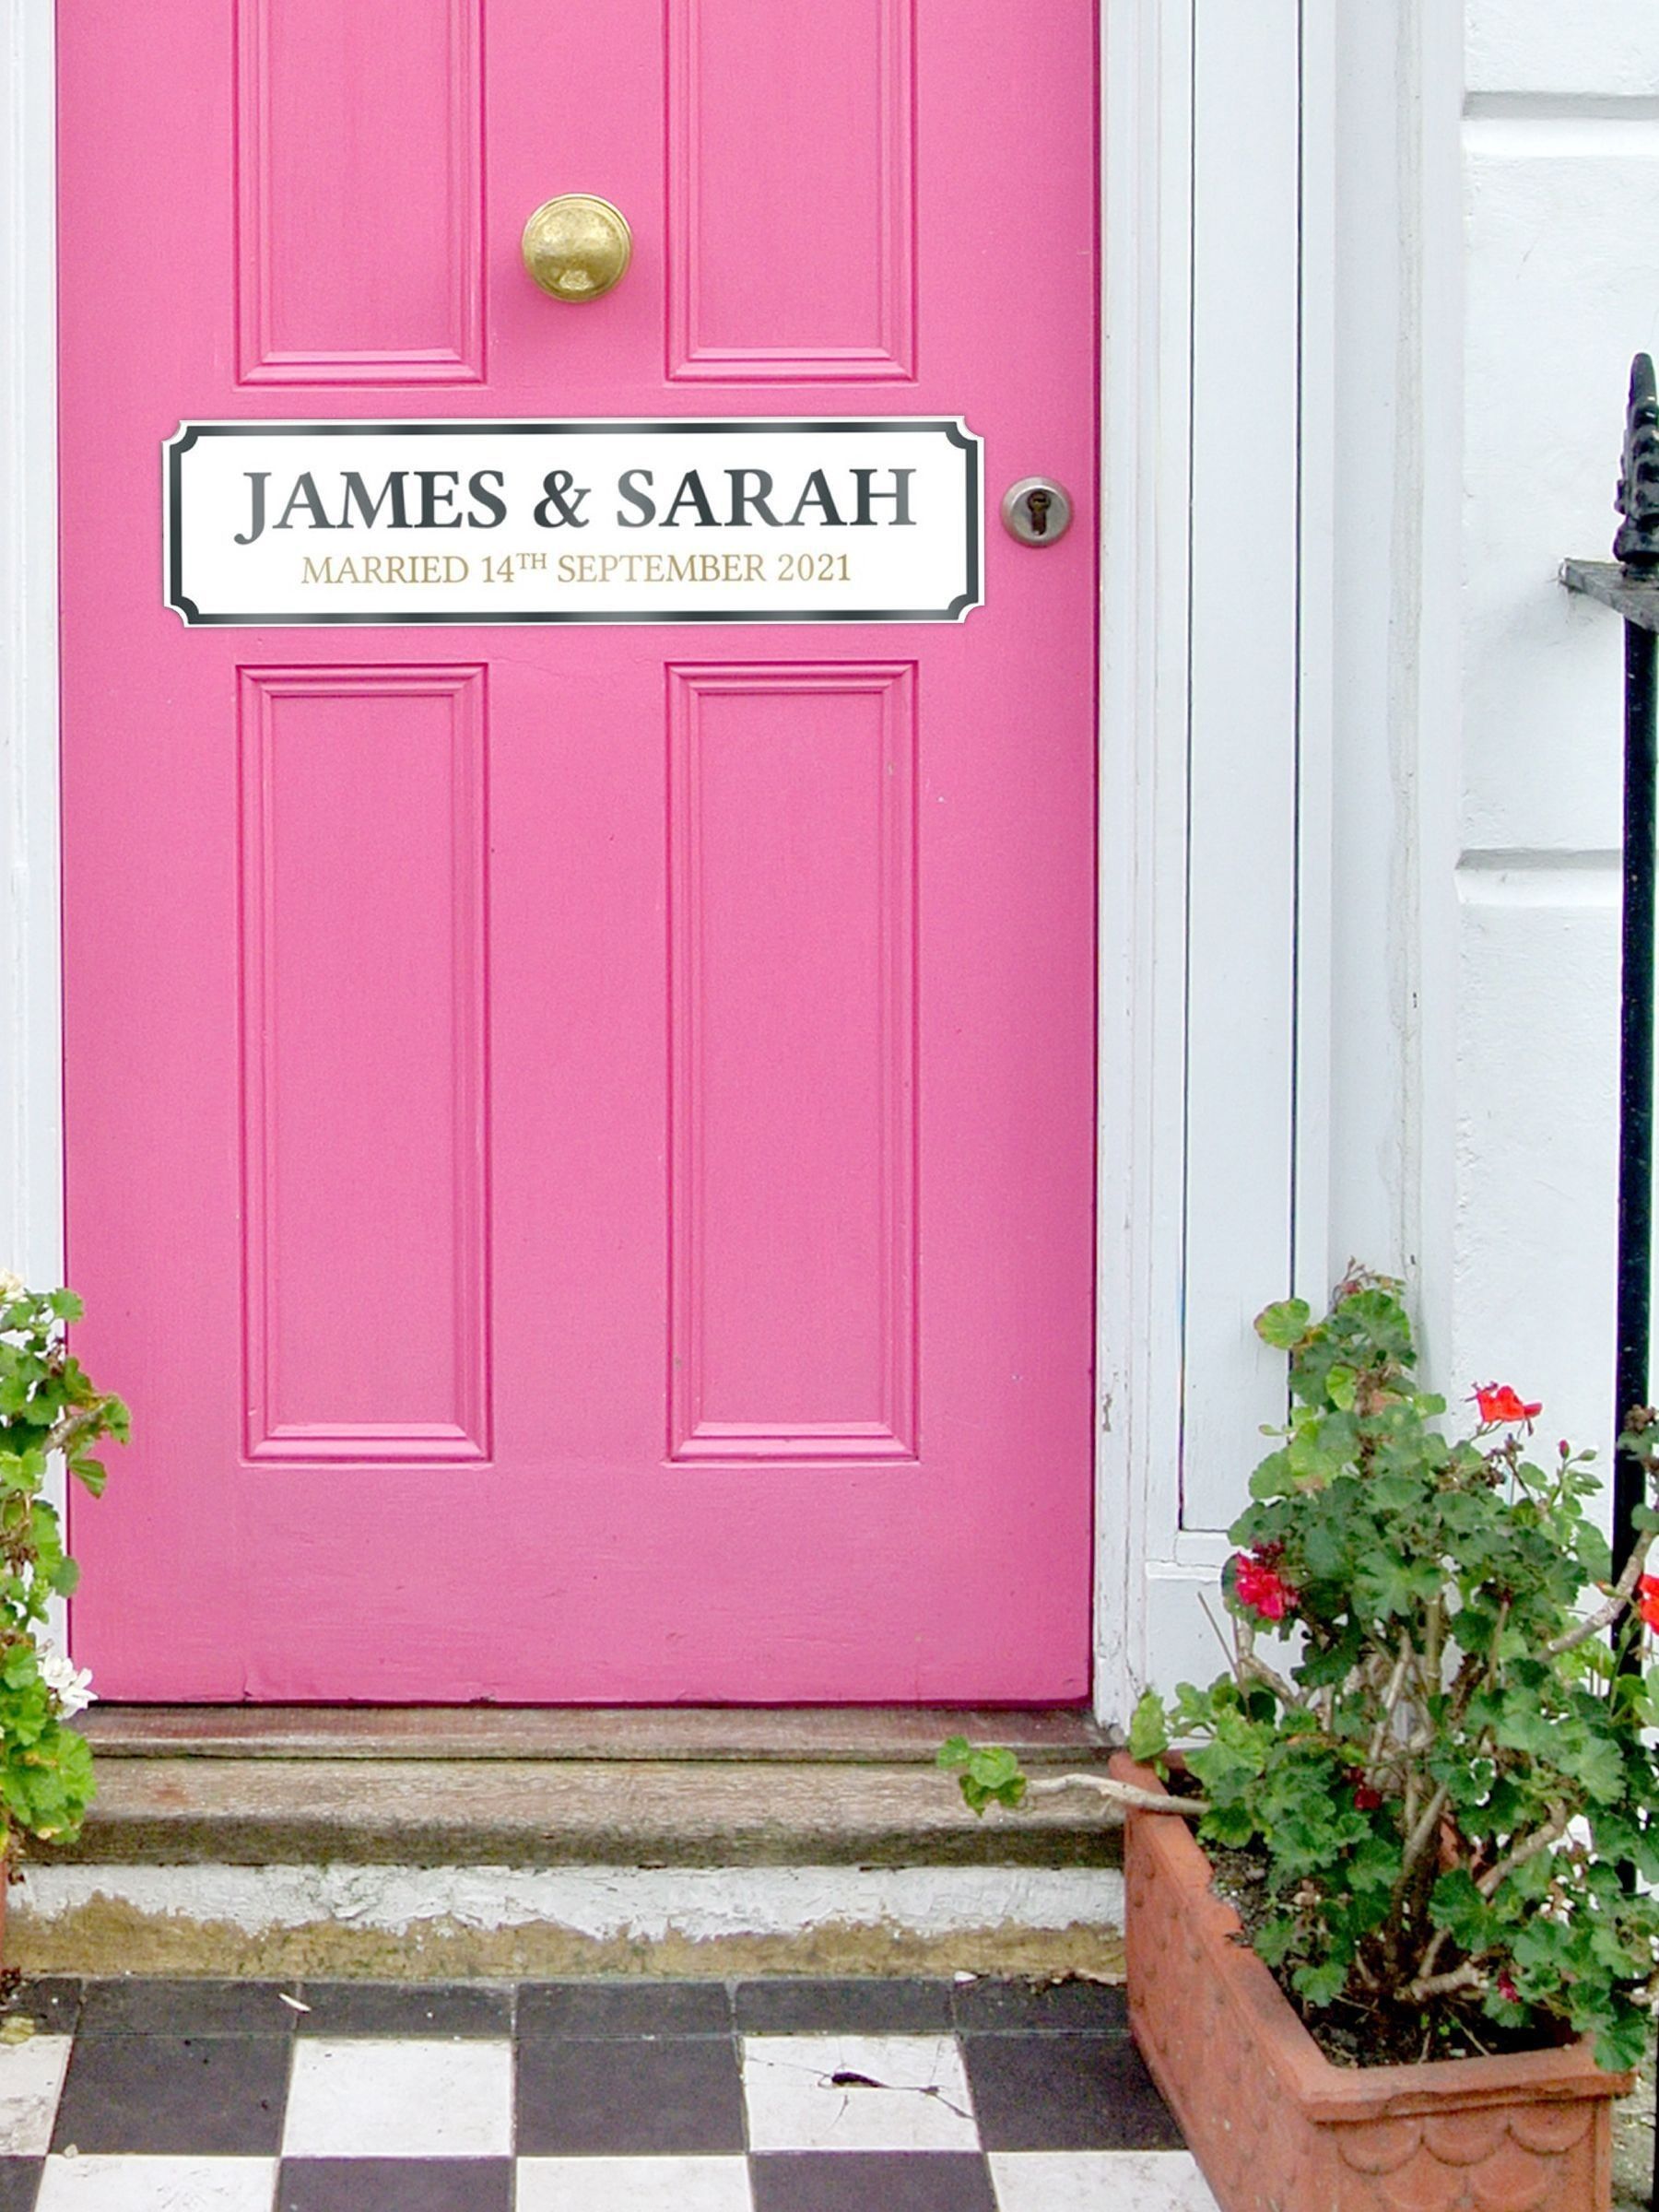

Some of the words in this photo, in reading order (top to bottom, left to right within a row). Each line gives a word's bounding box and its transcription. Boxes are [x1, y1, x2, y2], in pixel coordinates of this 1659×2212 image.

[234, 470, 508, 547] JAMES
[534, 469, 592, 529] &
[617, 468, 917, 530] SARAH
[300, 556, 469, 584] MARRIED
[558, 554, 766, 582] SEPTEMBER
[778, 553, 851, 582] 2021
